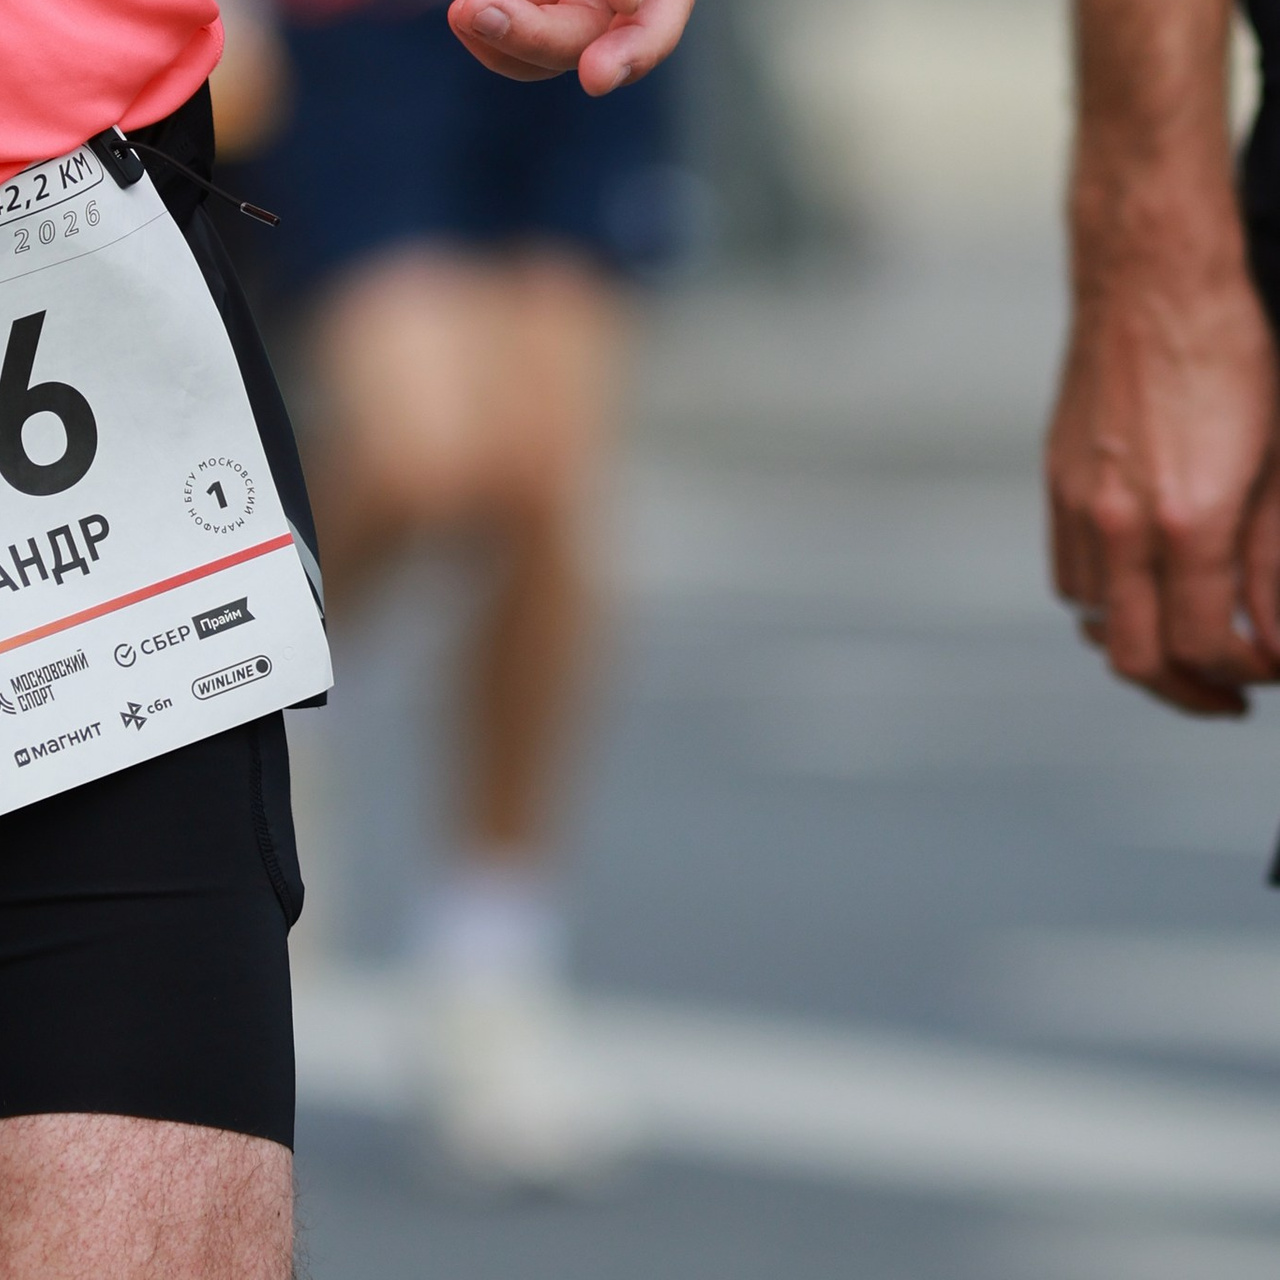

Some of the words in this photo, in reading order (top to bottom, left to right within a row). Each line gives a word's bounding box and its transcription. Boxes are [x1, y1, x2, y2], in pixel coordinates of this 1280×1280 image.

[59, 152, 93, 189] КМ
[13, 199, 101, 254] 2026
[184, 472, 197, 503] БЕГУ
[198, 457, 255, 515] МОСКОВСКИЙ
[206, 480, 228, 509] 1
[188, 507, 245, 534] МАРАФОН
[140, 625, 191, 655] СБЕР
[199, 608, 243, 632] Прайм
[9, 648, 90, 695] МОСКОВСКИЙ
[198, 663, 255, 696] WINLINE
[17, 684, 55, 713] СПОРТ
[147, 697, 173, 714] сбп
